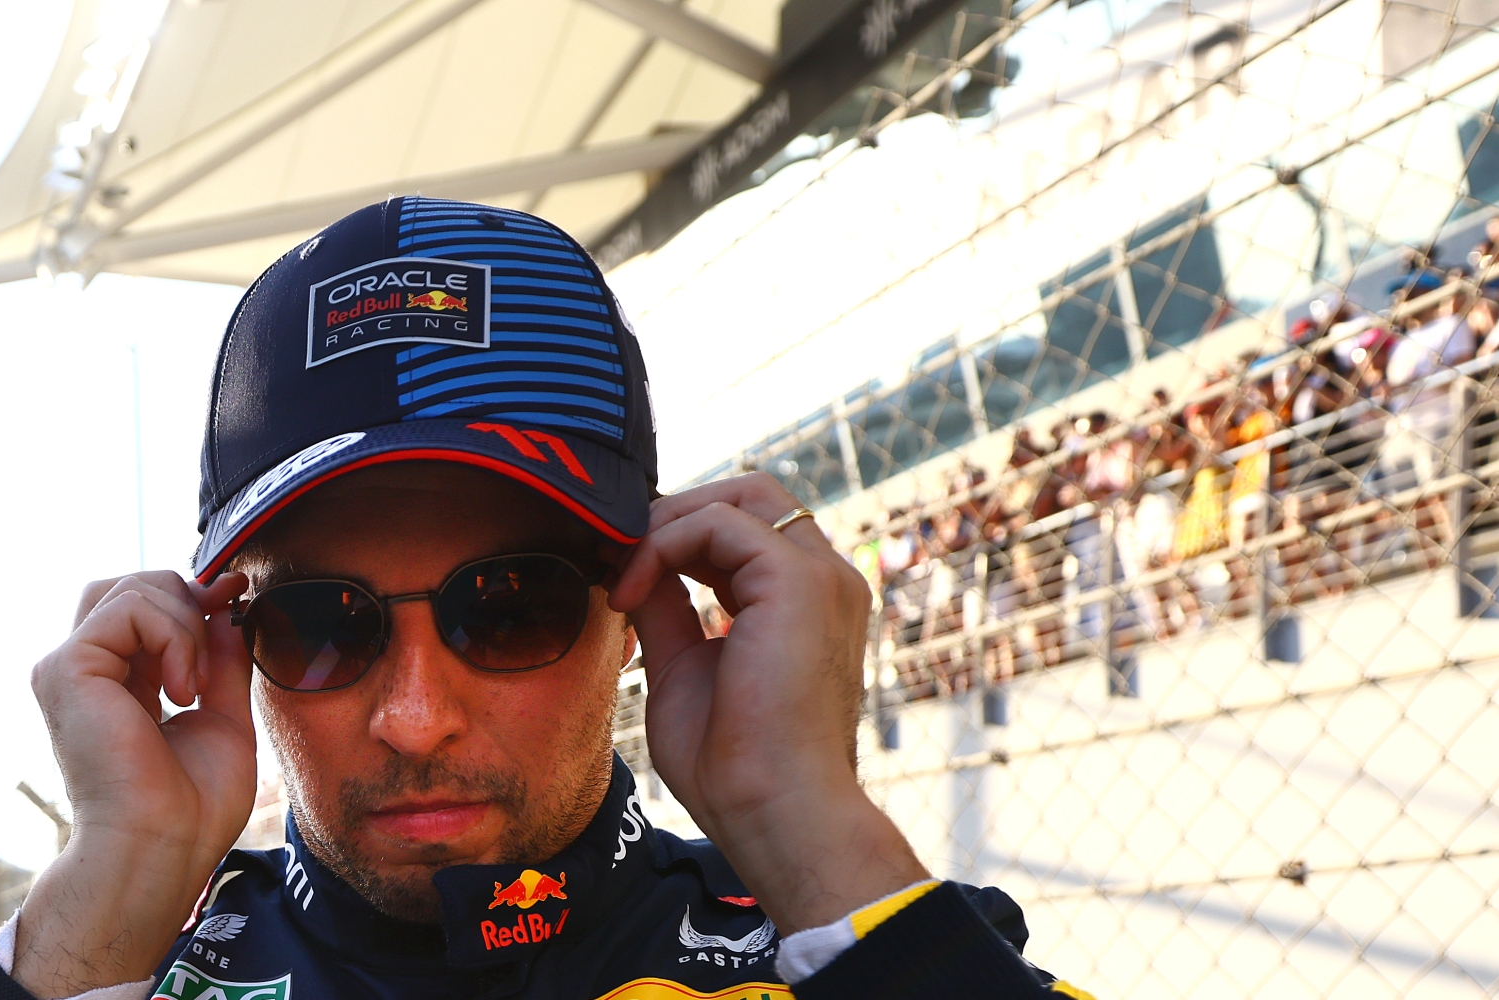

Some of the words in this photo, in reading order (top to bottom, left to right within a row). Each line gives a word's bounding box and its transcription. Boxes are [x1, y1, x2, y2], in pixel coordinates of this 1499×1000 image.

[328, 270, 468, 305] ORACLE
[326, 299, 361, 328] Red
[363, 292, 401, 315] Bull
[326, 317, 468, 347] RACING
[481, 914, 529, 951] Red
[679, 947, 776, 969] CASTOR
